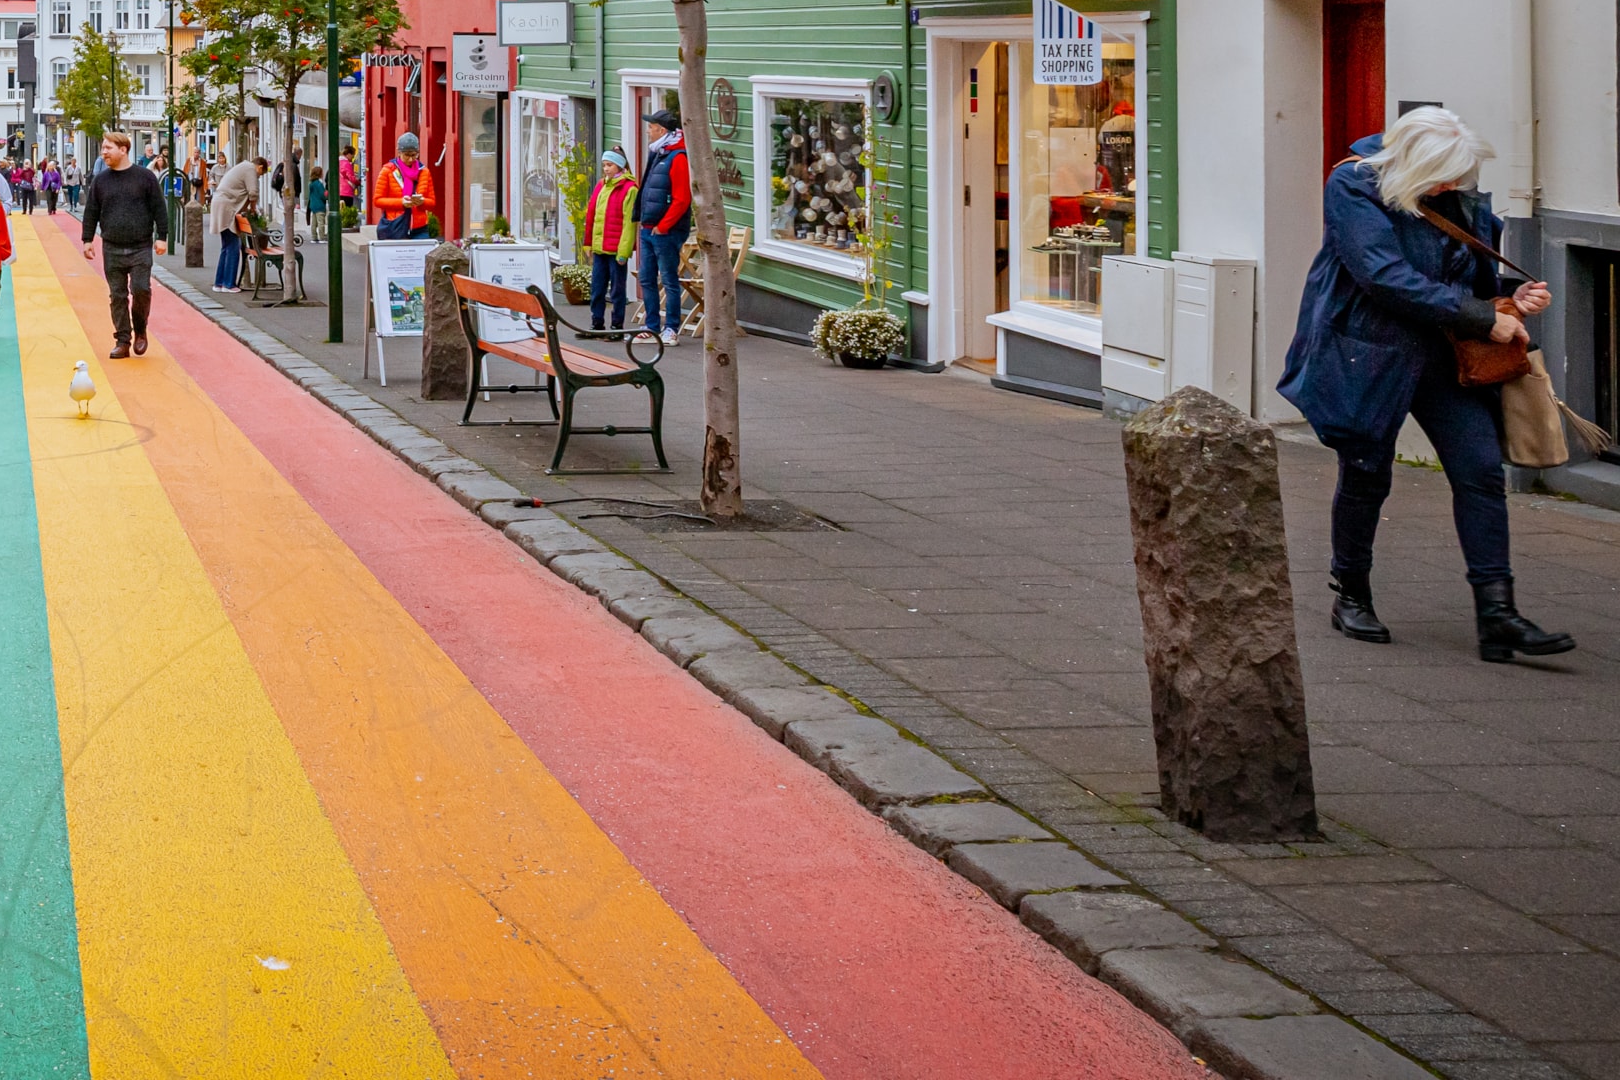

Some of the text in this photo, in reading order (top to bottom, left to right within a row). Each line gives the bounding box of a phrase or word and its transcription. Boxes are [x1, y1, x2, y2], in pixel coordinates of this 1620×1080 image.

[507, 15, 560, 29] Kaolin
[1042, 44, 1094, 58] TAX FREE
[1041, 60, 1094, 73] SHOPPING
